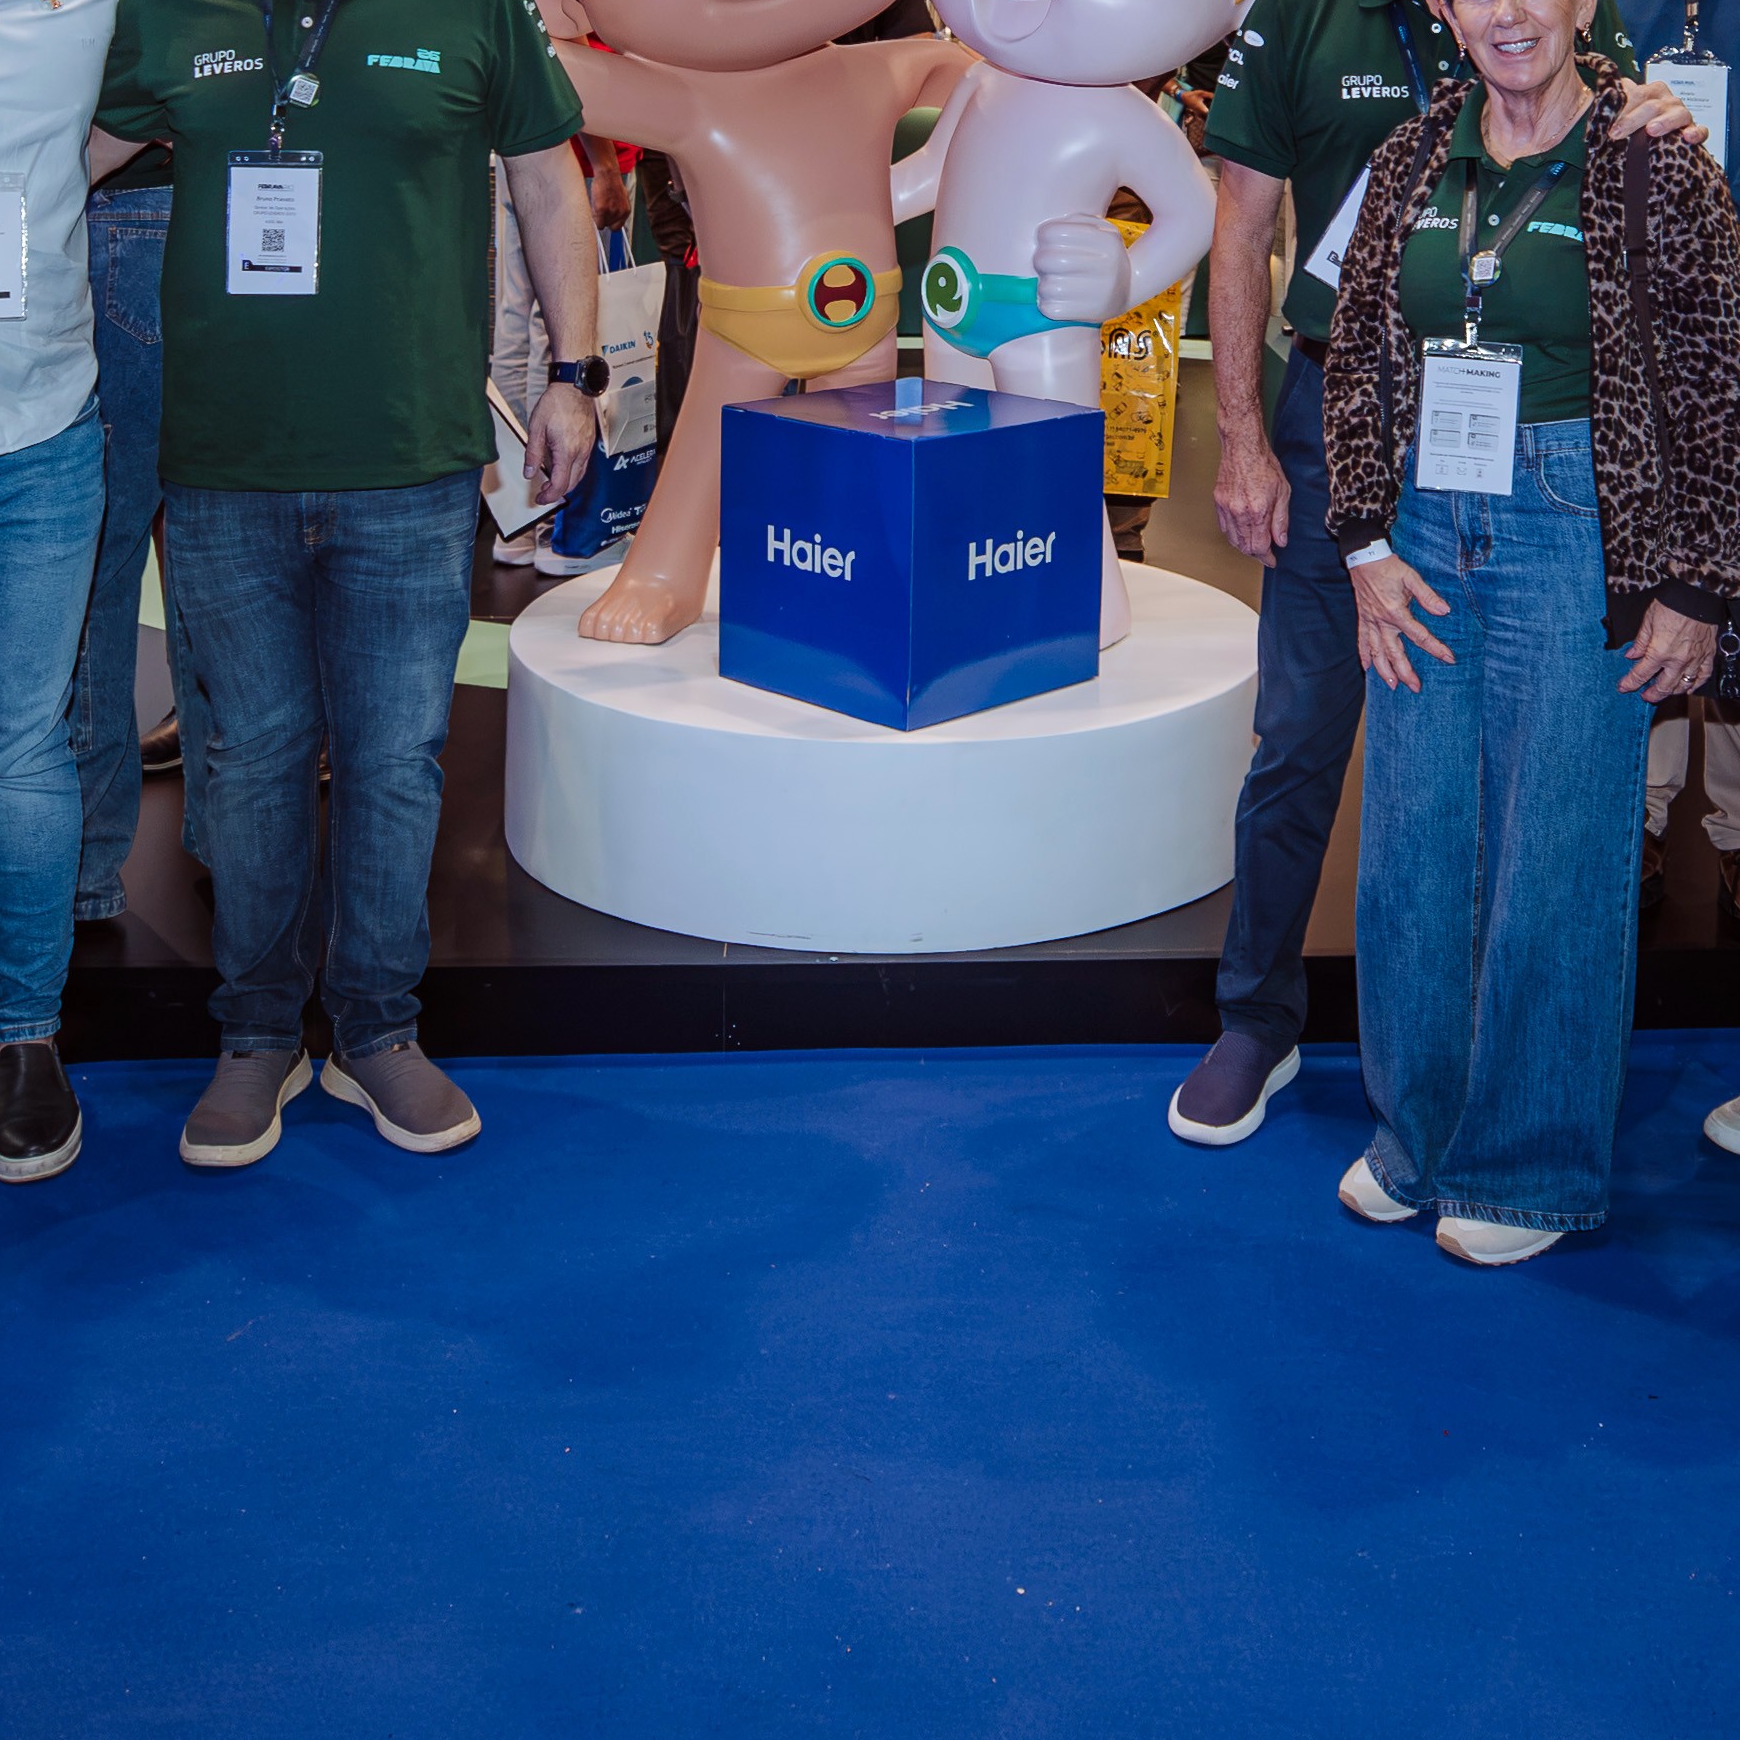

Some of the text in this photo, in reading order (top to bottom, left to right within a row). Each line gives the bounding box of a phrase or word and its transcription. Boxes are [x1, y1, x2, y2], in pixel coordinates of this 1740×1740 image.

[194, 49, 235, 66] GRUPO
[1228, 48, 1245, 66] CL
[194, 58, 264, 79] LEVEROS
[1341, 75, 1383, 87] GRUPO
[1341, 86, 1410, 100] LEVEROS
[609, 340, 636, 354] DAIKIN
[869, 400, 975, 420] Haier
[767, 525, 855, 581] Haier
[968, 530, 1056, 581] Haier
